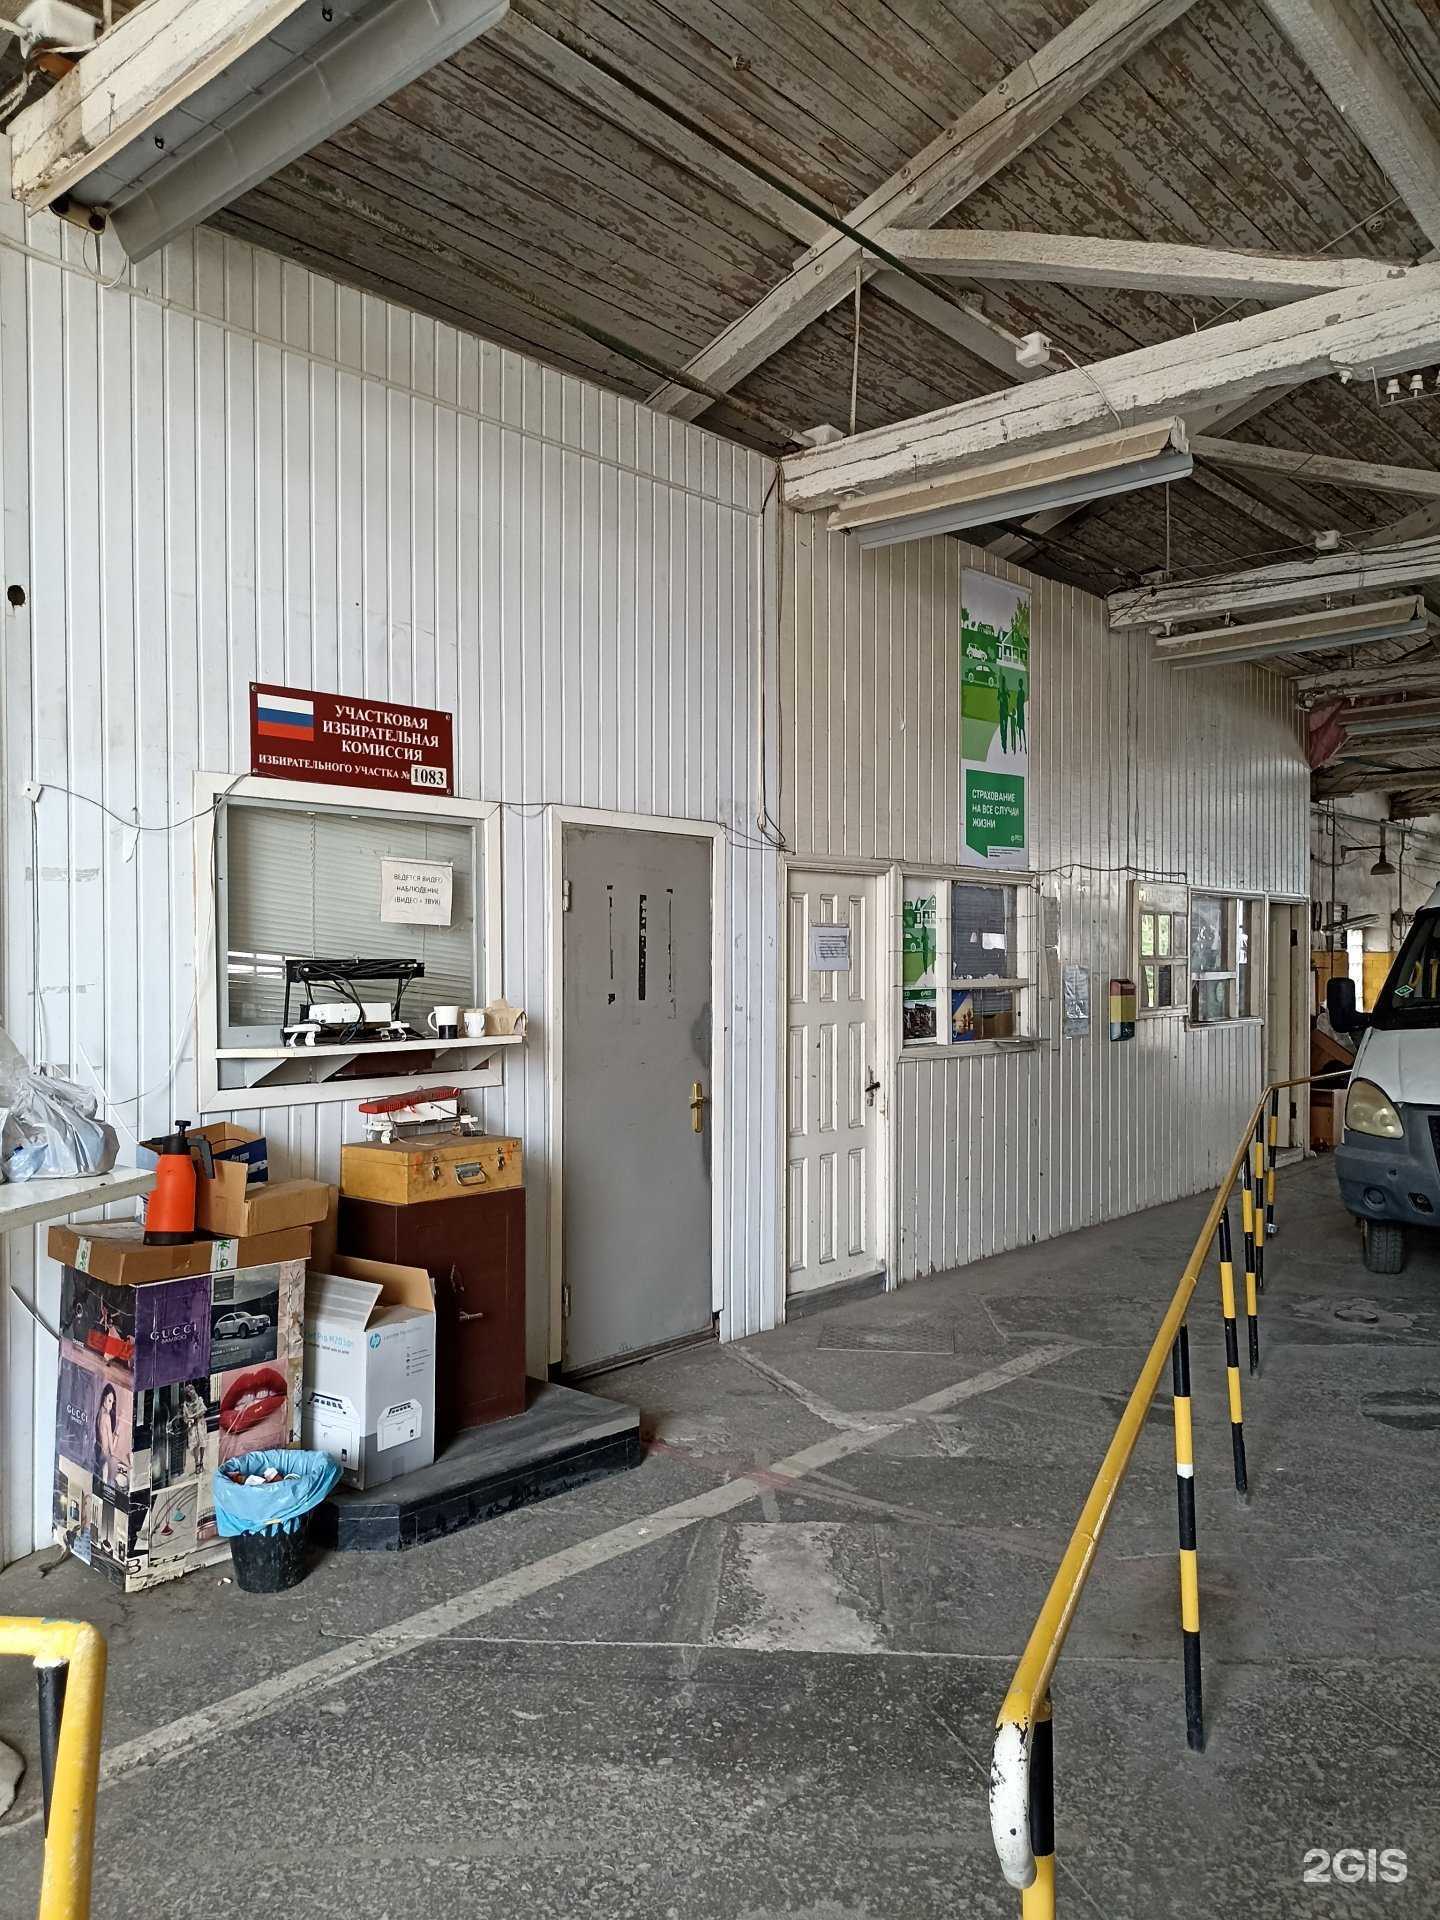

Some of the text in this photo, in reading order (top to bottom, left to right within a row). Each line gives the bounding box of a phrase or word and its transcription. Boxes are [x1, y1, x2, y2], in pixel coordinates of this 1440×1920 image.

[335, 704, 429, 731] УЧАСТКОВАЯ
[322, 720, 440, 748] ИЗБИРАТЕЛЬНАЯ
[341, 740, 423, 762] КОМИССИЯ
[258, 754, 352, 773] ИЗБИРАТЕЛЬНОГО
[354, 764, 399, 779] УЧАСТКА
[412, 768, 444, 786] 1083
[972, 788, 1016, 803] СТРАХОВАНИЕ
[972, 803, 981, 813] НА
[982, 804, 994, 815] ВСЕ
[972, 817, 996, 829] ЖИЗНИ
[150, 1323, 197, 1341] GUCCI
